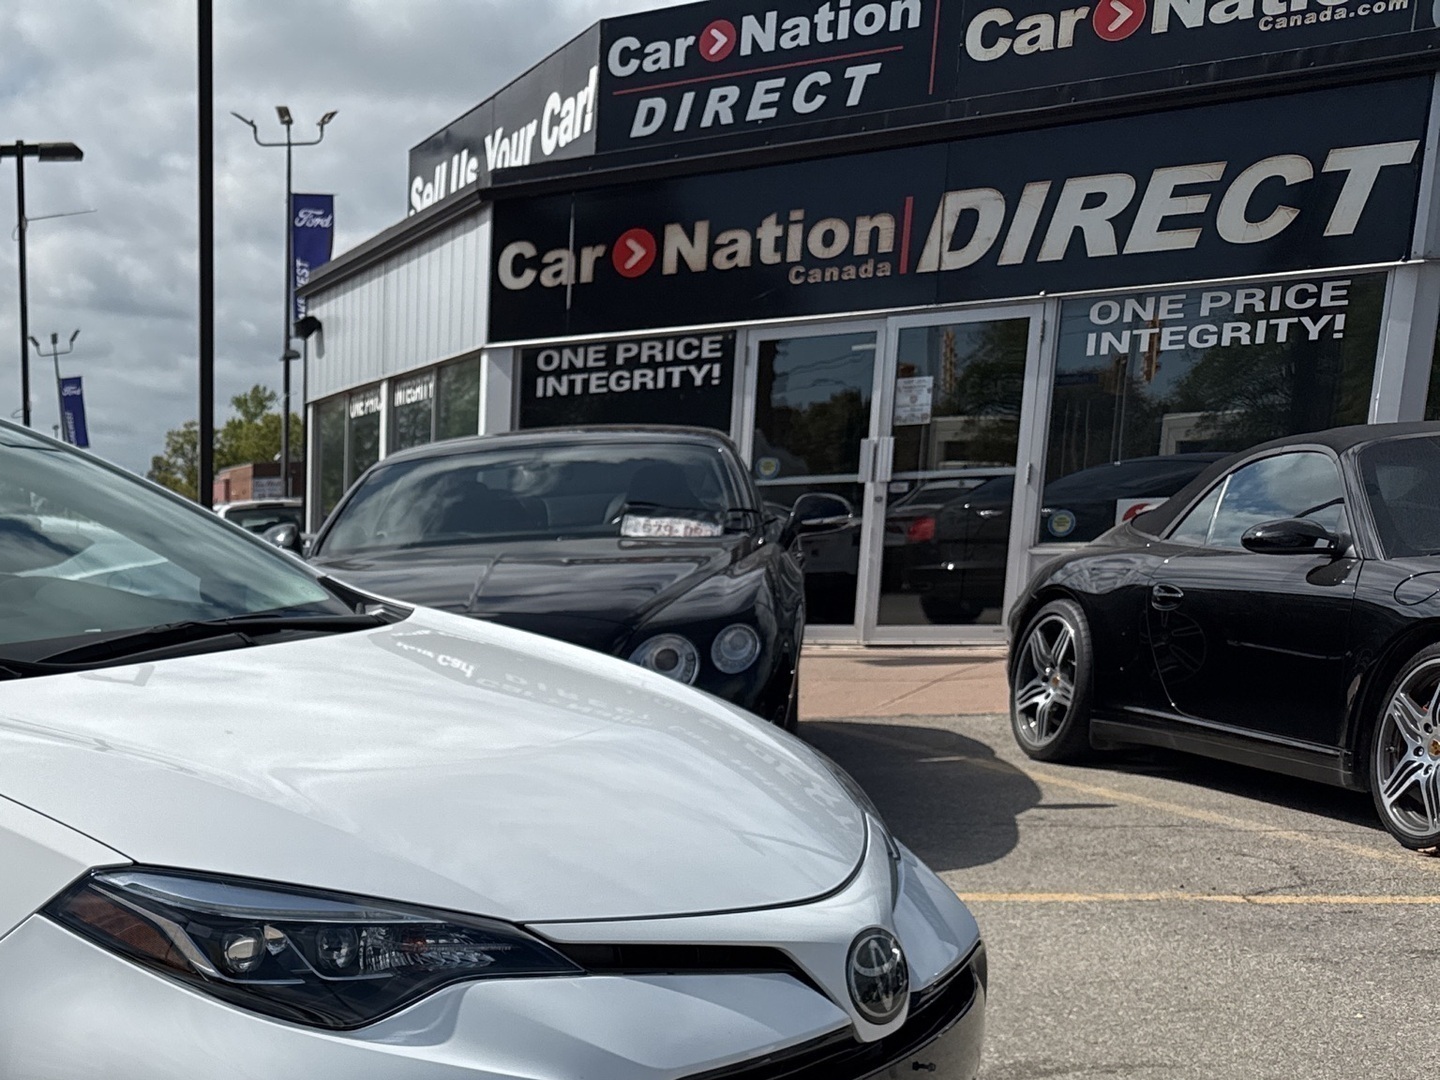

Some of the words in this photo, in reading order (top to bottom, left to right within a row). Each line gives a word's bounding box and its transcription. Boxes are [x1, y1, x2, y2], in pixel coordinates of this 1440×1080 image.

[608, 35, 696, 78] Car
[740, 0, 922, 57] Nation
[965, 6, 1089, 62] Car
[1258, 0, 1409, 33] Canada.com
[629, 62, 883, 139] DIRECT
[410, 161, 448, 216] Sell
[484, 119, 538, 172] Your
[541, 65, 598, 156] Car!
[294, 208, 333, 228] Ford
[916, 139, 1421, 274] DIRECT
[497, 240, 606, 291] Car
[662, 207, 896, 275] Nation
[787, 259, 891, 286] Canada
[1088, 294, 1186, 326] ONE
[1199, 280, 1352, 318] PRICE
[536, 346, 607, 373] ONE
[616, 335, 723, 366] PRICE
[1085, 313, 1346, 358] INTEGRITY!
[536, 363, 722, 399] INTEGRITY!
